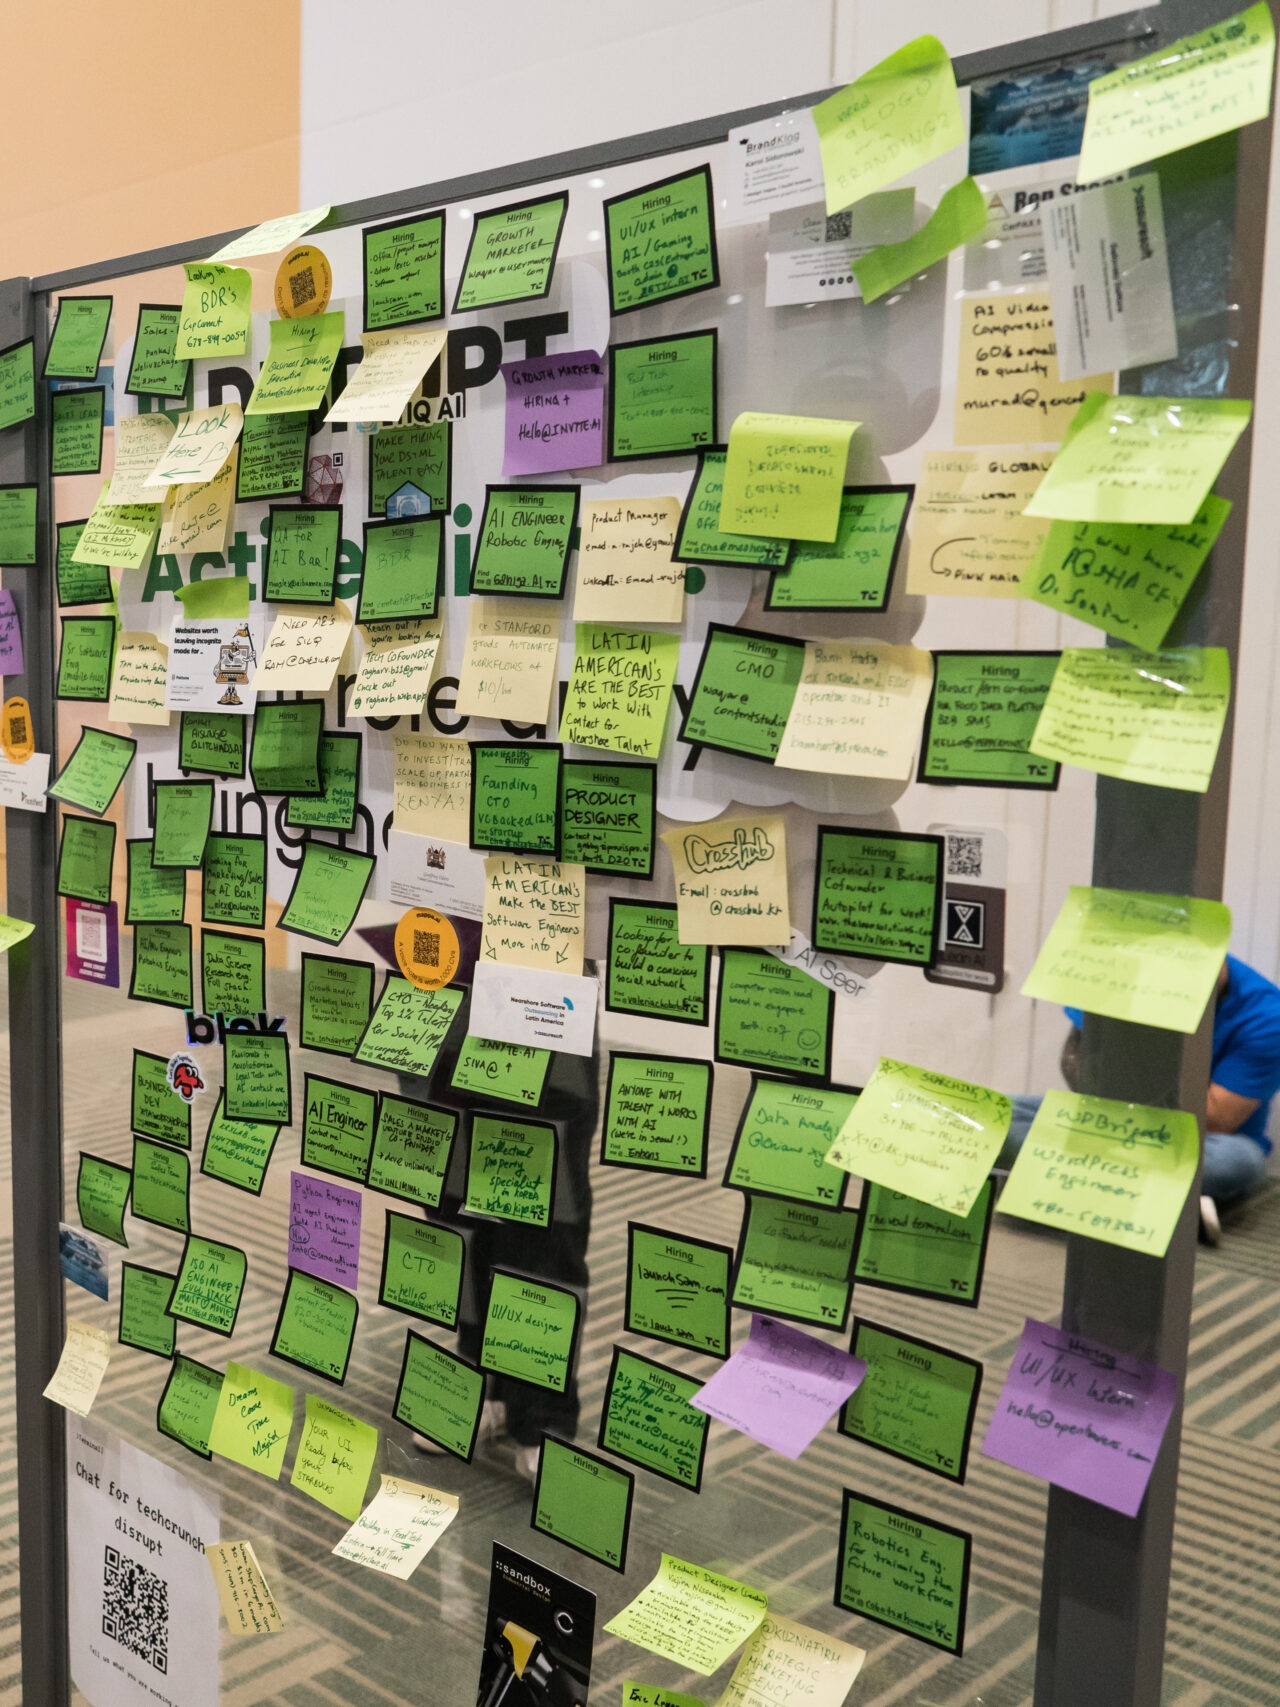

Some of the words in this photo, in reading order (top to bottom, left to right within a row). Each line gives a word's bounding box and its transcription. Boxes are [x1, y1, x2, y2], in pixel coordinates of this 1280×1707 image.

[642, 195, 671, 211] Hiring
[507, 211, 533, 224] Hiring
[620, 220, 655, 240] UI/UX
[662, 205, 698, 226] intern
[393, 232, 415, 242] Hiring
[487, 227, 535, 245] GROWTH
[486, 240, 553, 260] MARKETER
[649, 351, 677, 361] Hiring
[519, 495, 544, 506] Hiring
[295, 514, 315, 523] Hiring
[489, 508, 504, 527] AI
[175, 627, 201, 635] Websites
[495, 621, 552, 634] STANFORD
[174, 637, 196, 646] leaving
[592, 632, 652, 654] LATIN
[747, 641, 778, 658] Hiring
[736, 660, 775, 678] CMO
[981, 665, 1020, 678] Hiring
[573, 680, 597, 694] ARE
[602, 681, 623, 693] THE
[628, 682, 665, 700] BEST
[279, 712, 298, 720] Hiring
[483, 775, 537, 799] Founding
[593, 774, 619, 785] Hiring
[566, 789, 637, 806] PRODUCT
[565, 810, 640, 828] DESIGNER
[862, 845, 896, 860] Hiring
[503, 861, 562, 877] LATIN
[551, 900, 580, 914] BEST
[646, 915, 674, 928] Hiring
[327, 968, 347, 980] Hiring
[760, 963, 791, 978] Hiring
[540, 1001, 566, 1010] Software
[542, 1017, 564, 1025] America
[646, 1068, 674, 1080] Hiring
[331, 1091, 350, 1104] Hiring
[308, 1100, 323, 1122] AI
[408, 1107, 429, 1121] Hiring
[681, 1156, 696, 1165] TC
[666, 1245, 694, 1262] Hiring
[522, 1288, 547, 1304] Hiring
[76, 1461, 100, 1489] Chat
[109, 1481, 129, 1504] for
[137, 1497, 206, 1555] techcrunch
[888, 1516, 922, 1538] Hiring
[115, 1516, 162, 1556] disrupt
